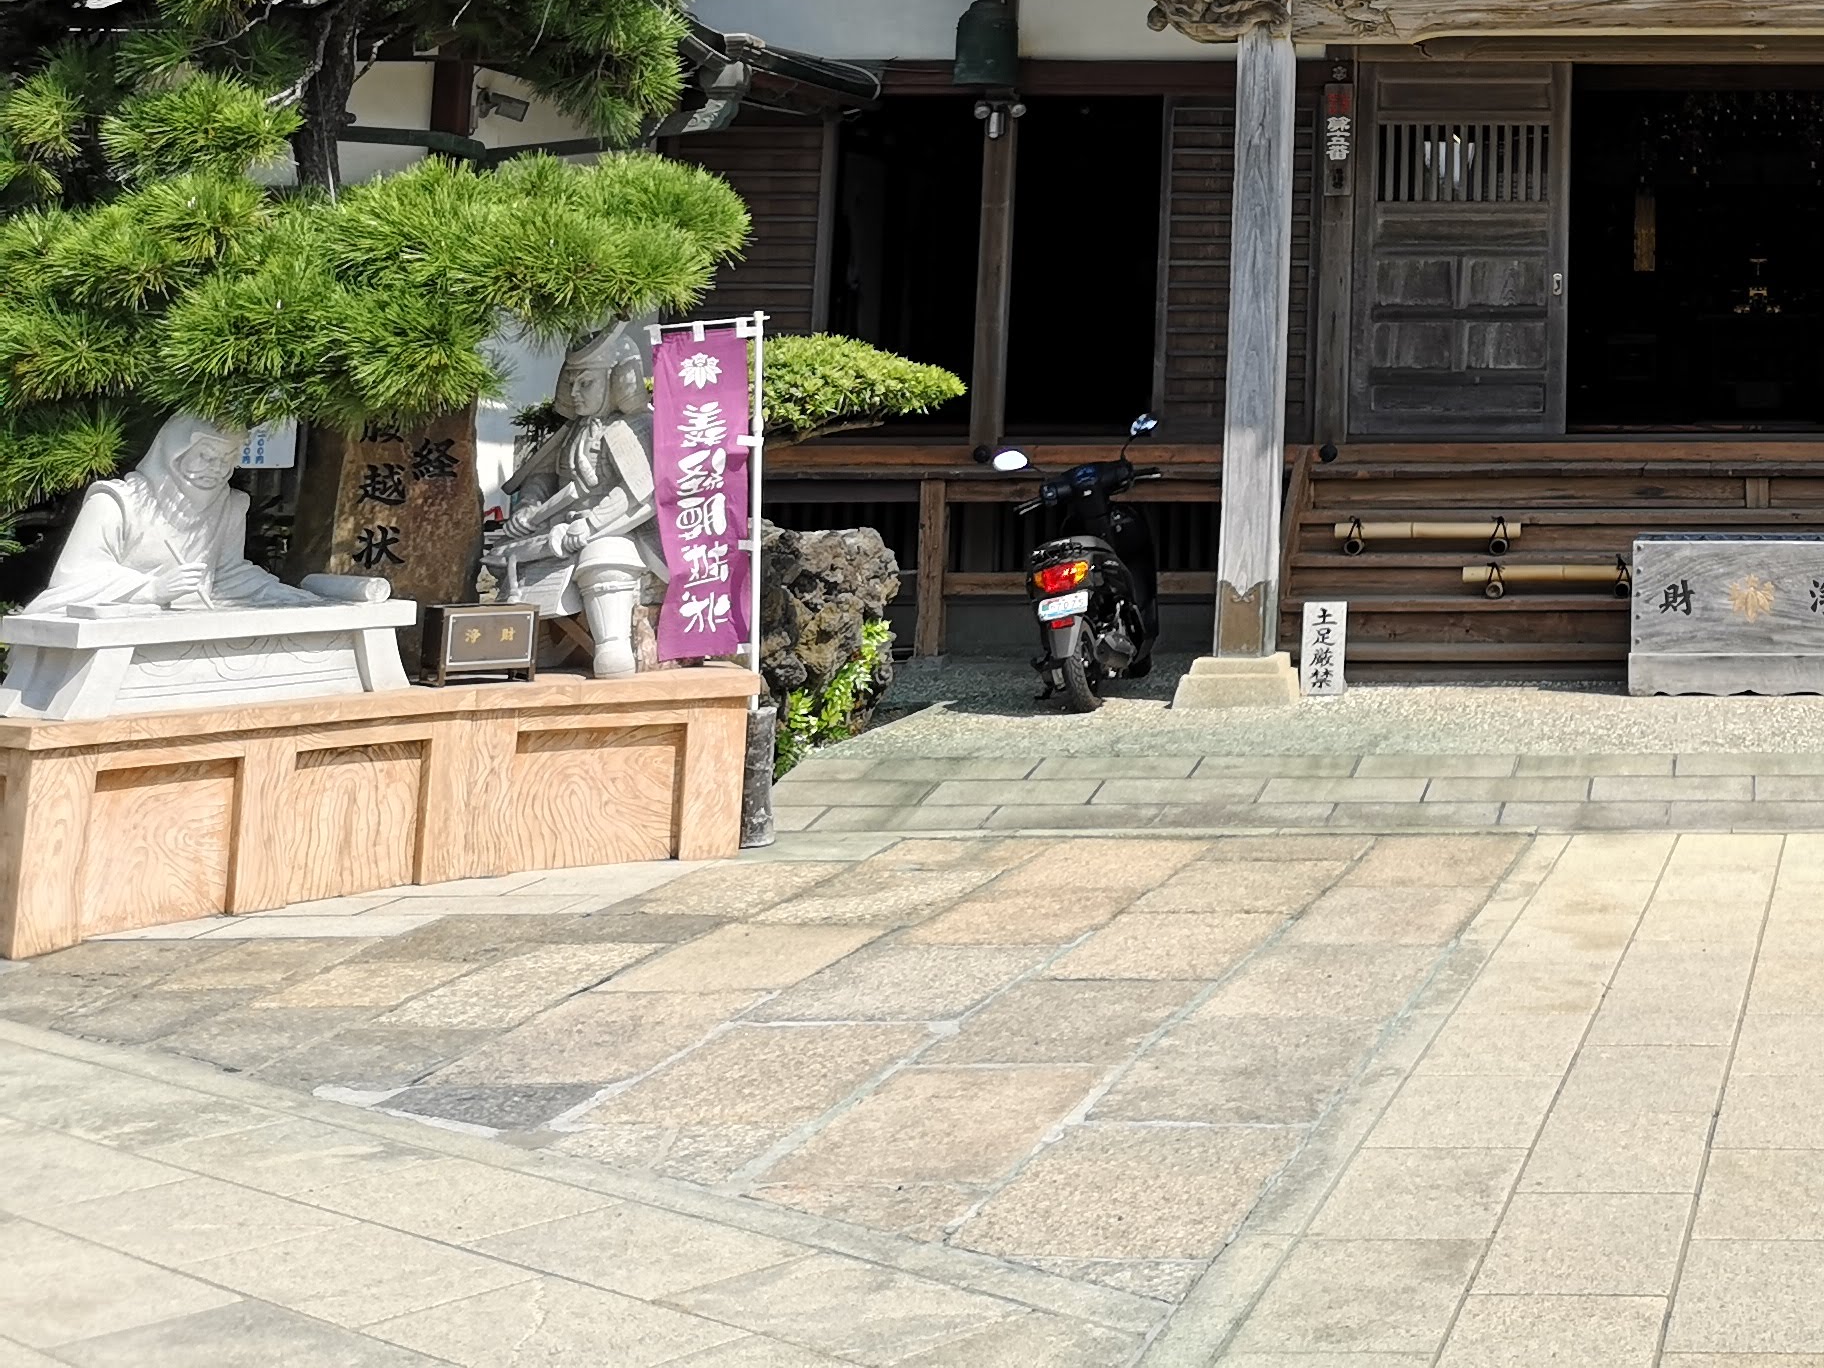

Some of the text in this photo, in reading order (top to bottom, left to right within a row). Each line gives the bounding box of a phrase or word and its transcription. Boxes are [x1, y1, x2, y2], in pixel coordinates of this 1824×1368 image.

[1659, 578, 1696, 616] 財
[1309, 607, 1338, 689] 土足厳禁
